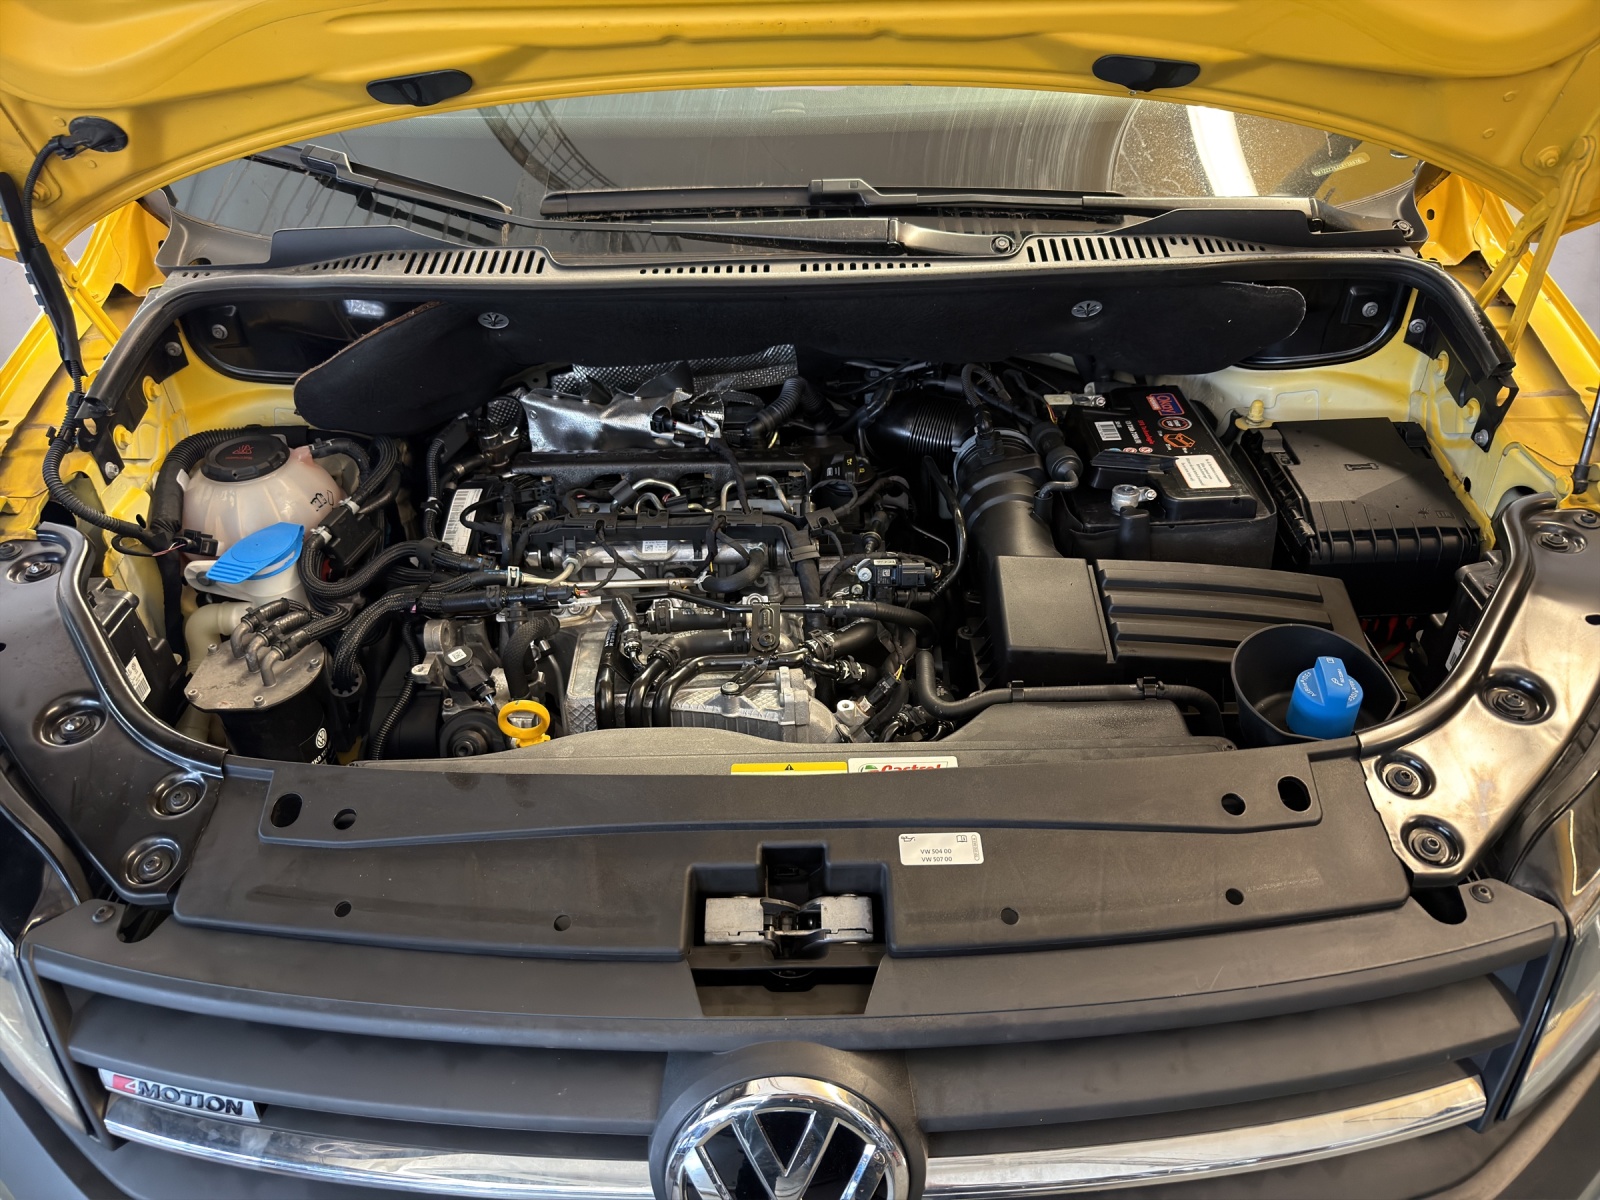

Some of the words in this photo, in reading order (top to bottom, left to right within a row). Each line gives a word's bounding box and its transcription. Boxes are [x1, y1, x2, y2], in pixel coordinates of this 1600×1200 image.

[1156, 395, 1176, 414] Okay
[881, 764, 941, 772] Cast
[125, 1080, 244, 1116] 4MOTION
